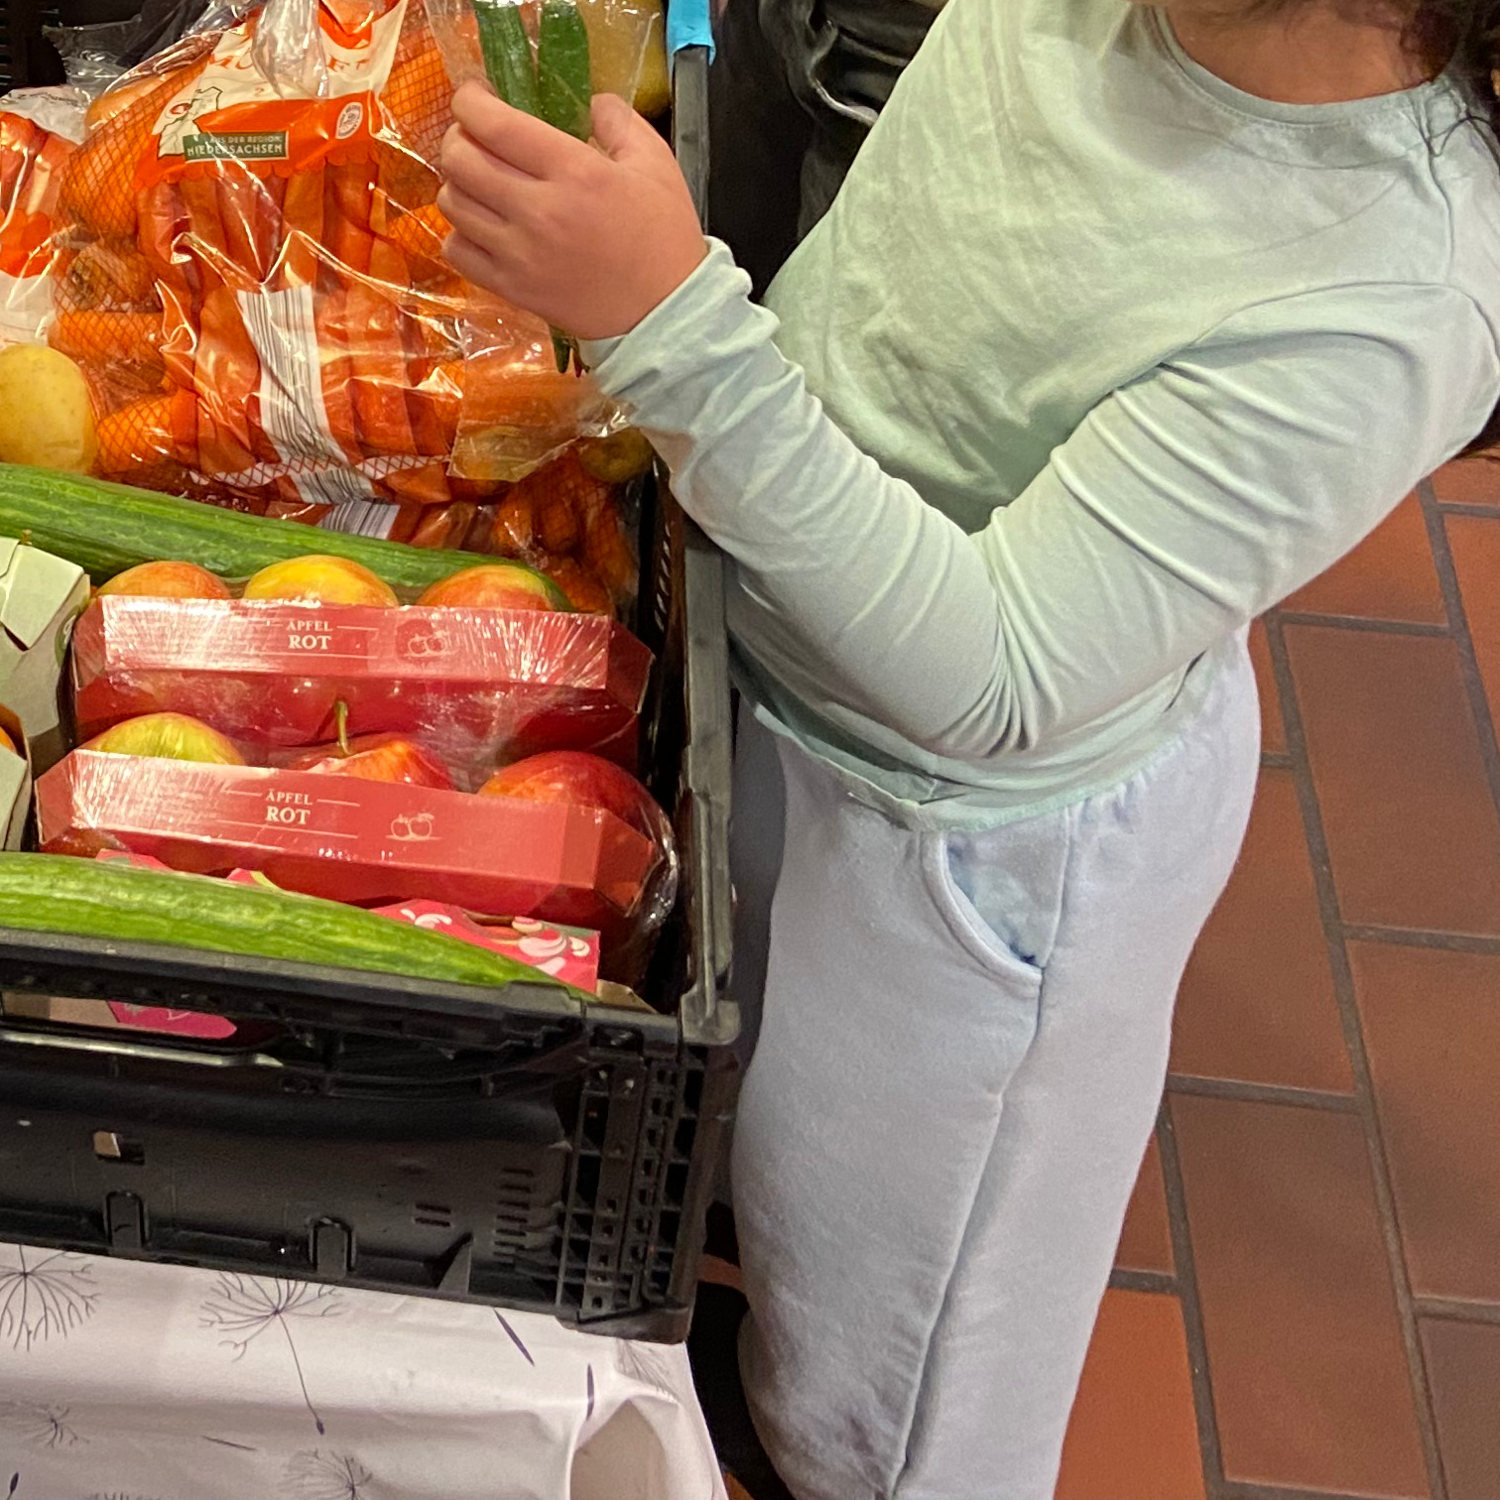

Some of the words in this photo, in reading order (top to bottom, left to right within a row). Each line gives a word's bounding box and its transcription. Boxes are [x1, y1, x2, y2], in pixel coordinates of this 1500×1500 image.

[228, 135, 245, 144] DER
[187, 144, 282, 156] NIEDERSACHSEN
[288, 634, 332, 651] ROT
[265, 788, 313, 805] ÄPFEL
[265, 806, 310, 825] ROT
